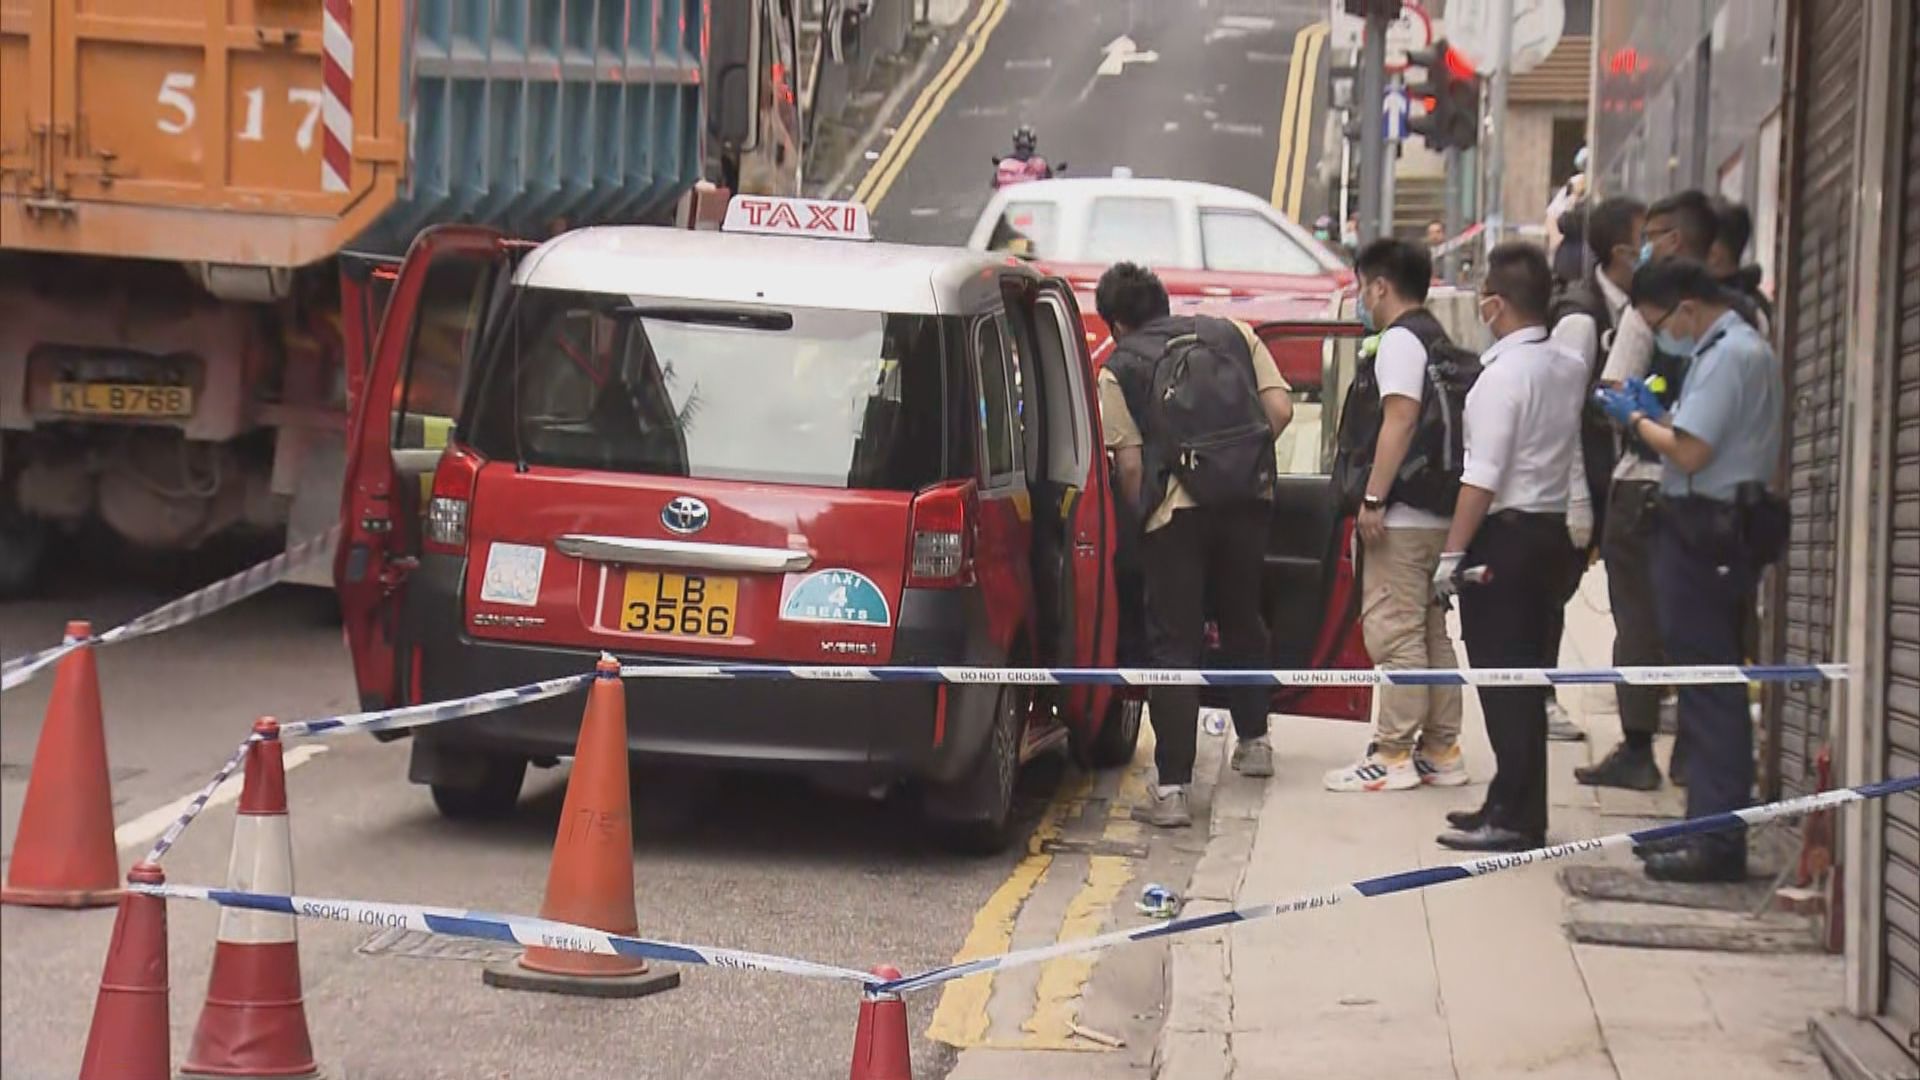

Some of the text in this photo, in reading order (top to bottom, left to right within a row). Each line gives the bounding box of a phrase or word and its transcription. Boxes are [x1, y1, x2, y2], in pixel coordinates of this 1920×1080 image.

[741, 200, 856, 232] TAXI
[61, 387, 183, 411] KL 8768
[656, 573, 705, 604] LB
[820, 572, 862, 588] TAXI
[829, 586, 847, 607] 4
[627, 602, 729, 635] 3566
[960, 671, 1046, 682] DO NOT CROSS
[1292, 672, 1381, 683] DO NOT CROSS
[1476, 853, 1533, 875] CROSS
[302, 902, 349, 922] CROSS
